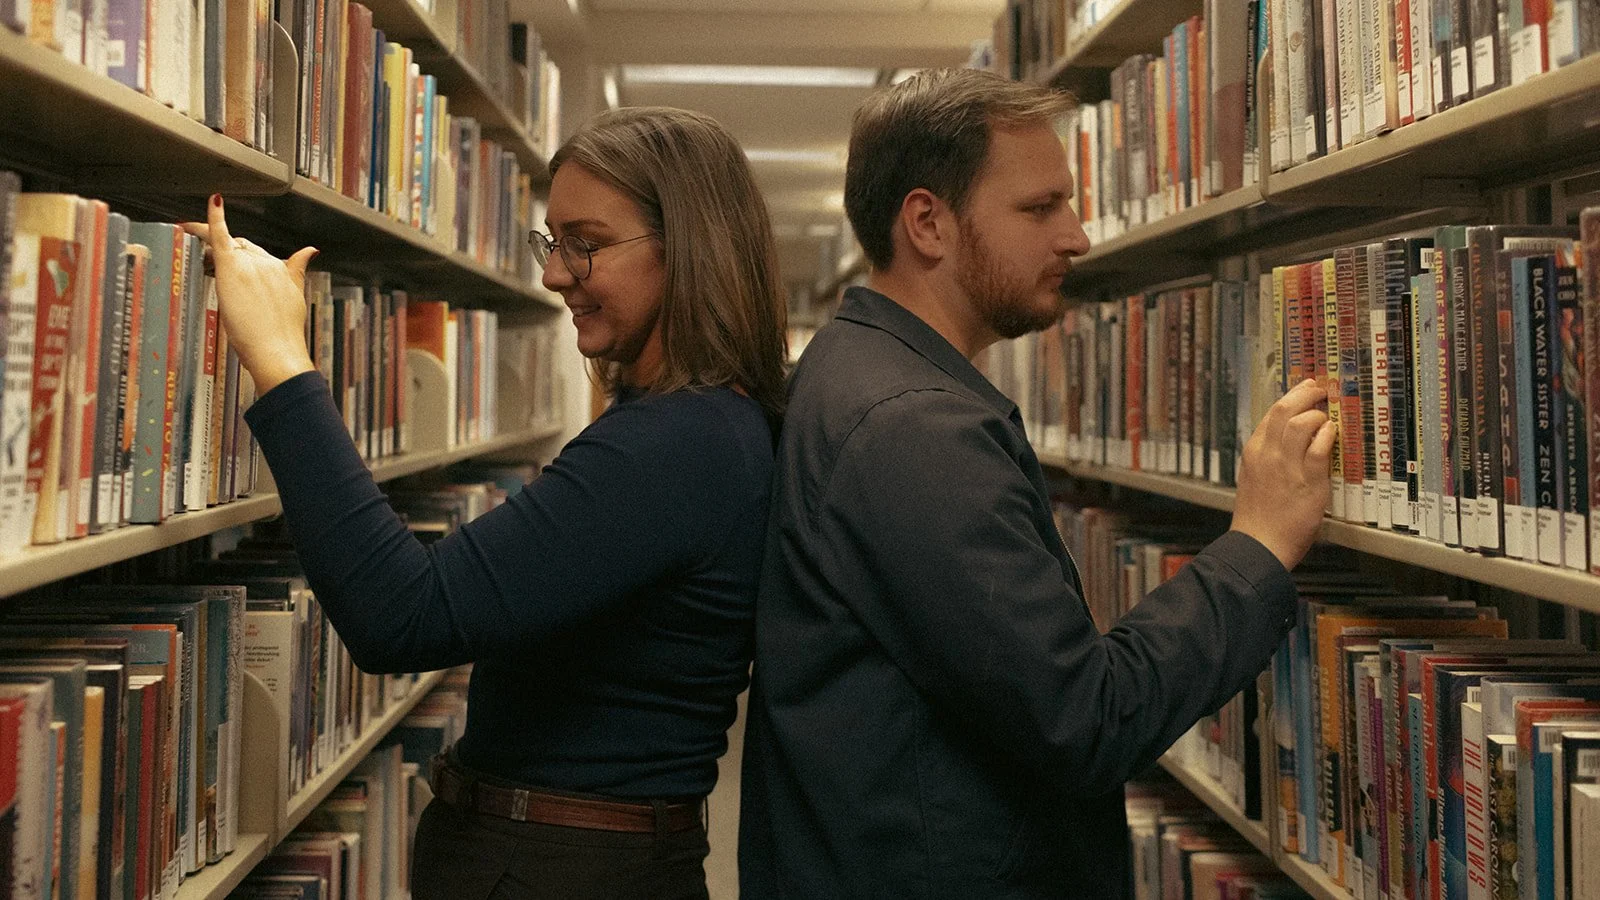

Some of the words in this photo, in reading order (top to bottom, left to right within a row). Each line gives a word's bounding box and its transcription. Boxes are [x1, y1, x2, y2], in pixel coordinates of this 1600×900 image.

[1372, 0, 1380, 40] BOARD
[172, 248, 182, 297] FORD
[1434, 251, 1444, 284] KING
[1453, 266, 1466, 308] GWENDY'S
[1302, 295, 1313, 319] LEE
[1325, 291, 1337, 321] LEE
[1436, 289, 1444, 307] OF
[1532, 268, 1545, 319] BLACK
[206, 314, 214, 371] FORD
[1437, 313, 1446, 340] THE
[1455, 310, 1466, 335] MAGIC
[1303, 327, 1315, 373] CHILD
[1326, 324, 1339, 372] CHILD
[1375, 332, 1388, 396] DEATH
[1455, 338, 1467, 372] FEATHER
[1535, 324, 1547, 376] WATER
[1438, 347, 1449, 441] ARMADILLOS
[1457, 398, 1469, 433] RICHARD
[1499, 354, 1512, 467] SAHA
[1537, 383, 1549, 429] SISTER
[1377, 406, 1392, 474] MATCH
[1459, 436, 1471, 471] CHIZMAR
[1566, 403, 1577, 461] SPIRITS
[1539, 445, 1551, 483] ZEN
[1464, 738, 1482, 773] THE
[1437, 786, 1446, 831] Silver
[1489, 775, 1498, 817] LAST
[1466, 781, 1487, 889] HOLLOWS
